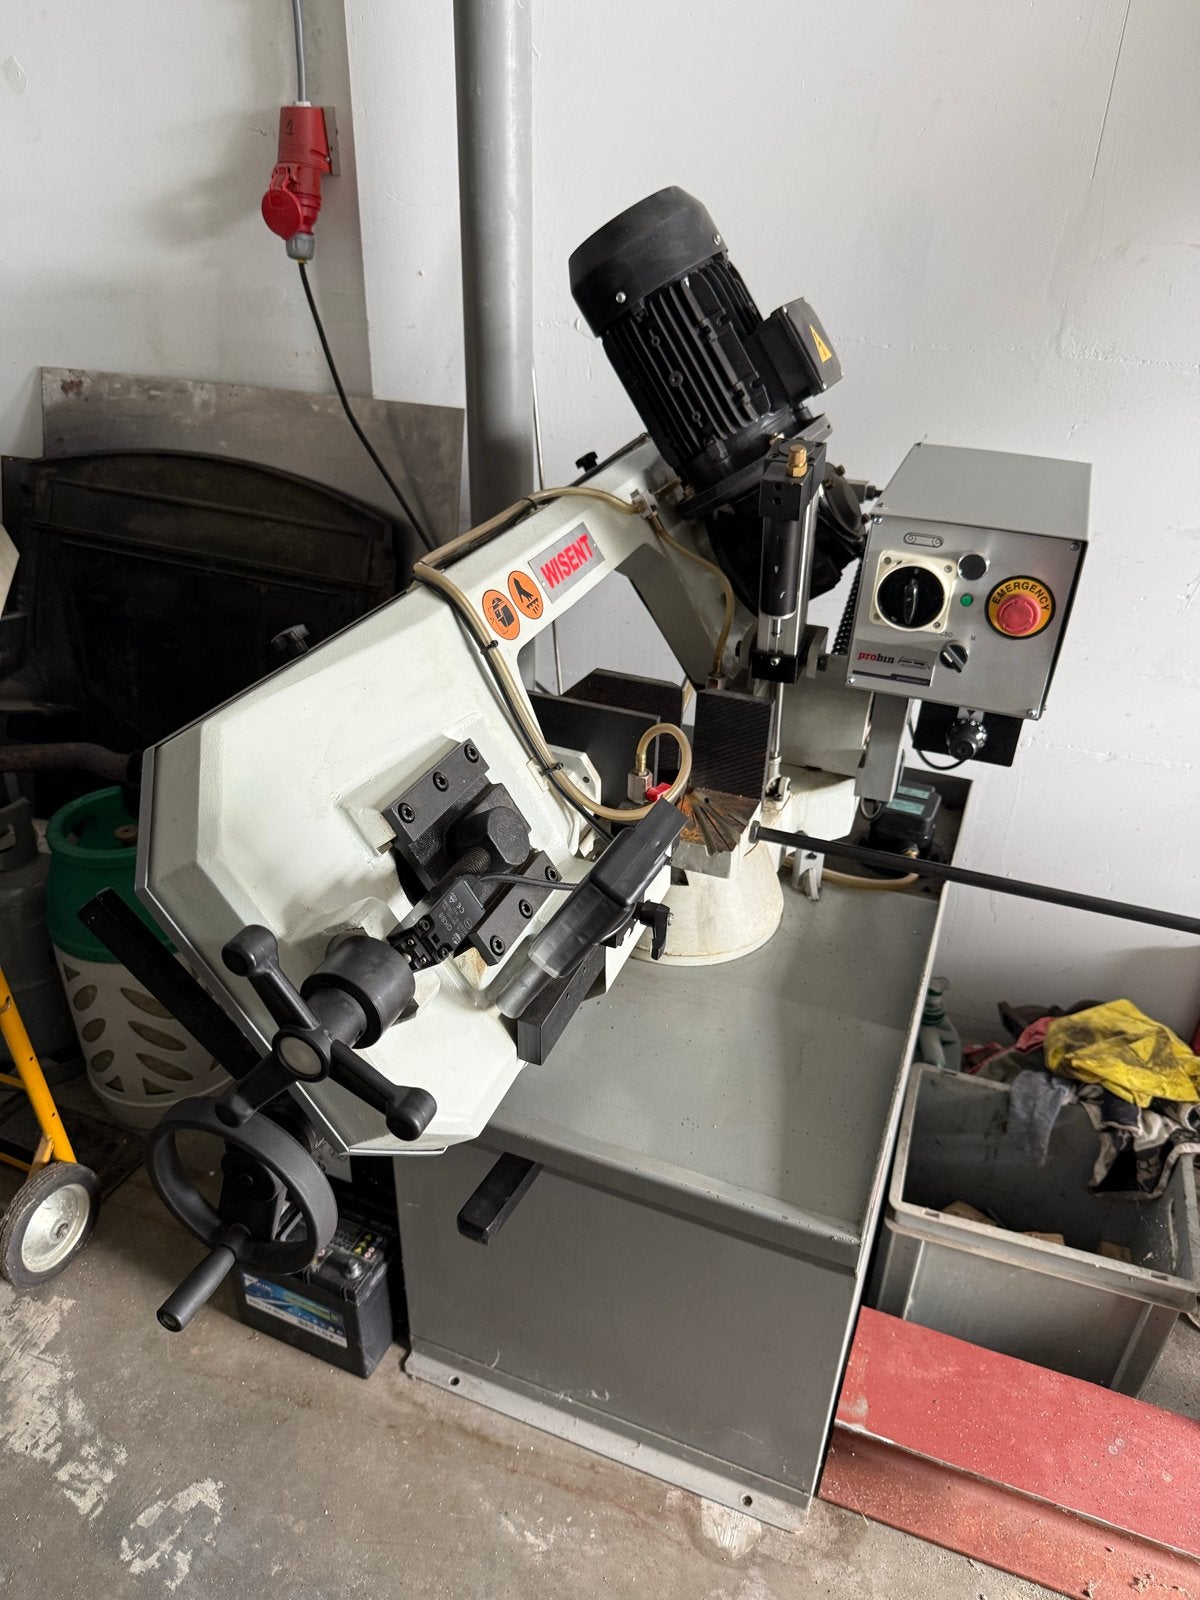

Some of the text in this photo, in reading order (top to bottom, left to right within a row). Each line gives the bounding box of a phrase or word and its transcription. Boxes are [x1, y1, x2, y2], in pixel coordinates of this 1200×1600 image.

[540, 534, 593, 589] WISENT
[992, 581, 1051, 612] EMERGENCY
[857, 650, 895, 665] probin
